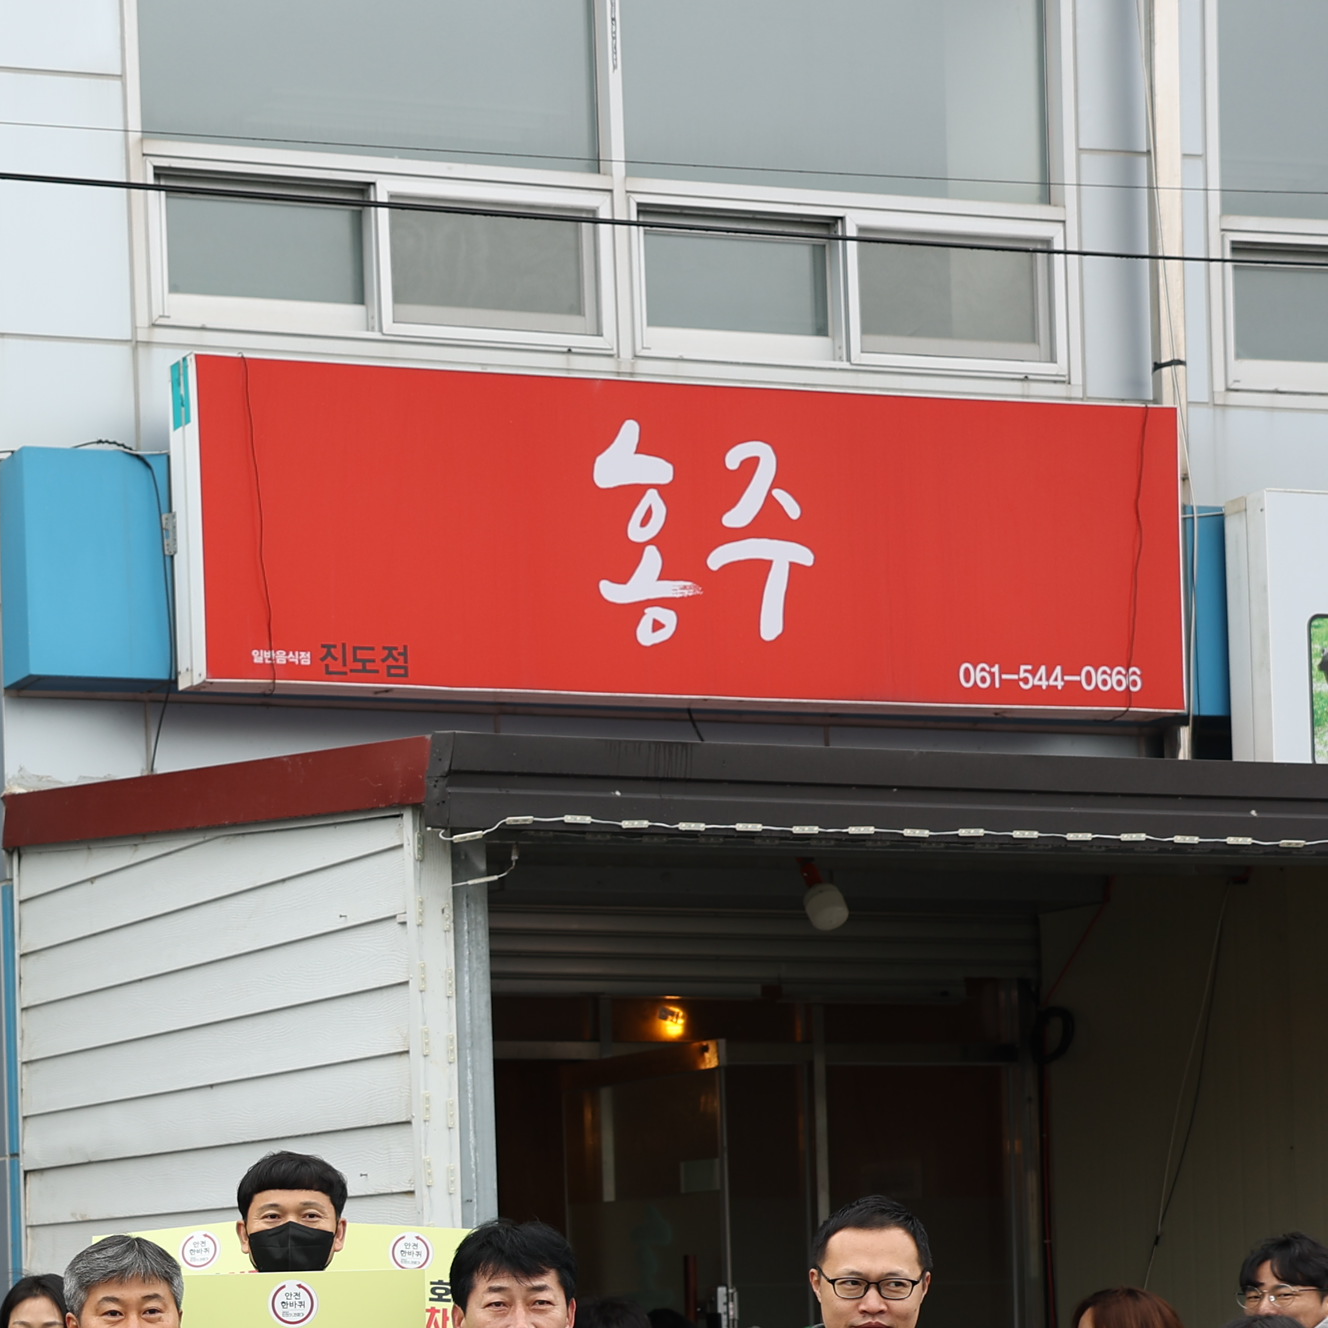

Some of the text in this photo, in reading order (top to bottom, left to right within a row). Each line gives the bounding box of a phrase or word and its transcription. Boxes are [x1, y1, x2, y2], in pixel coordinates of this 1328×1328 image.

[594, 420, 814, 646] 홍주
[251, 642, 410, 678] 일반음식점 진도점
[959, 662, 1143, 692] 061-544-0666
[281, 1300, 306, 1310] 한바퀴
[284, 1292, 301, 1301] 안전
